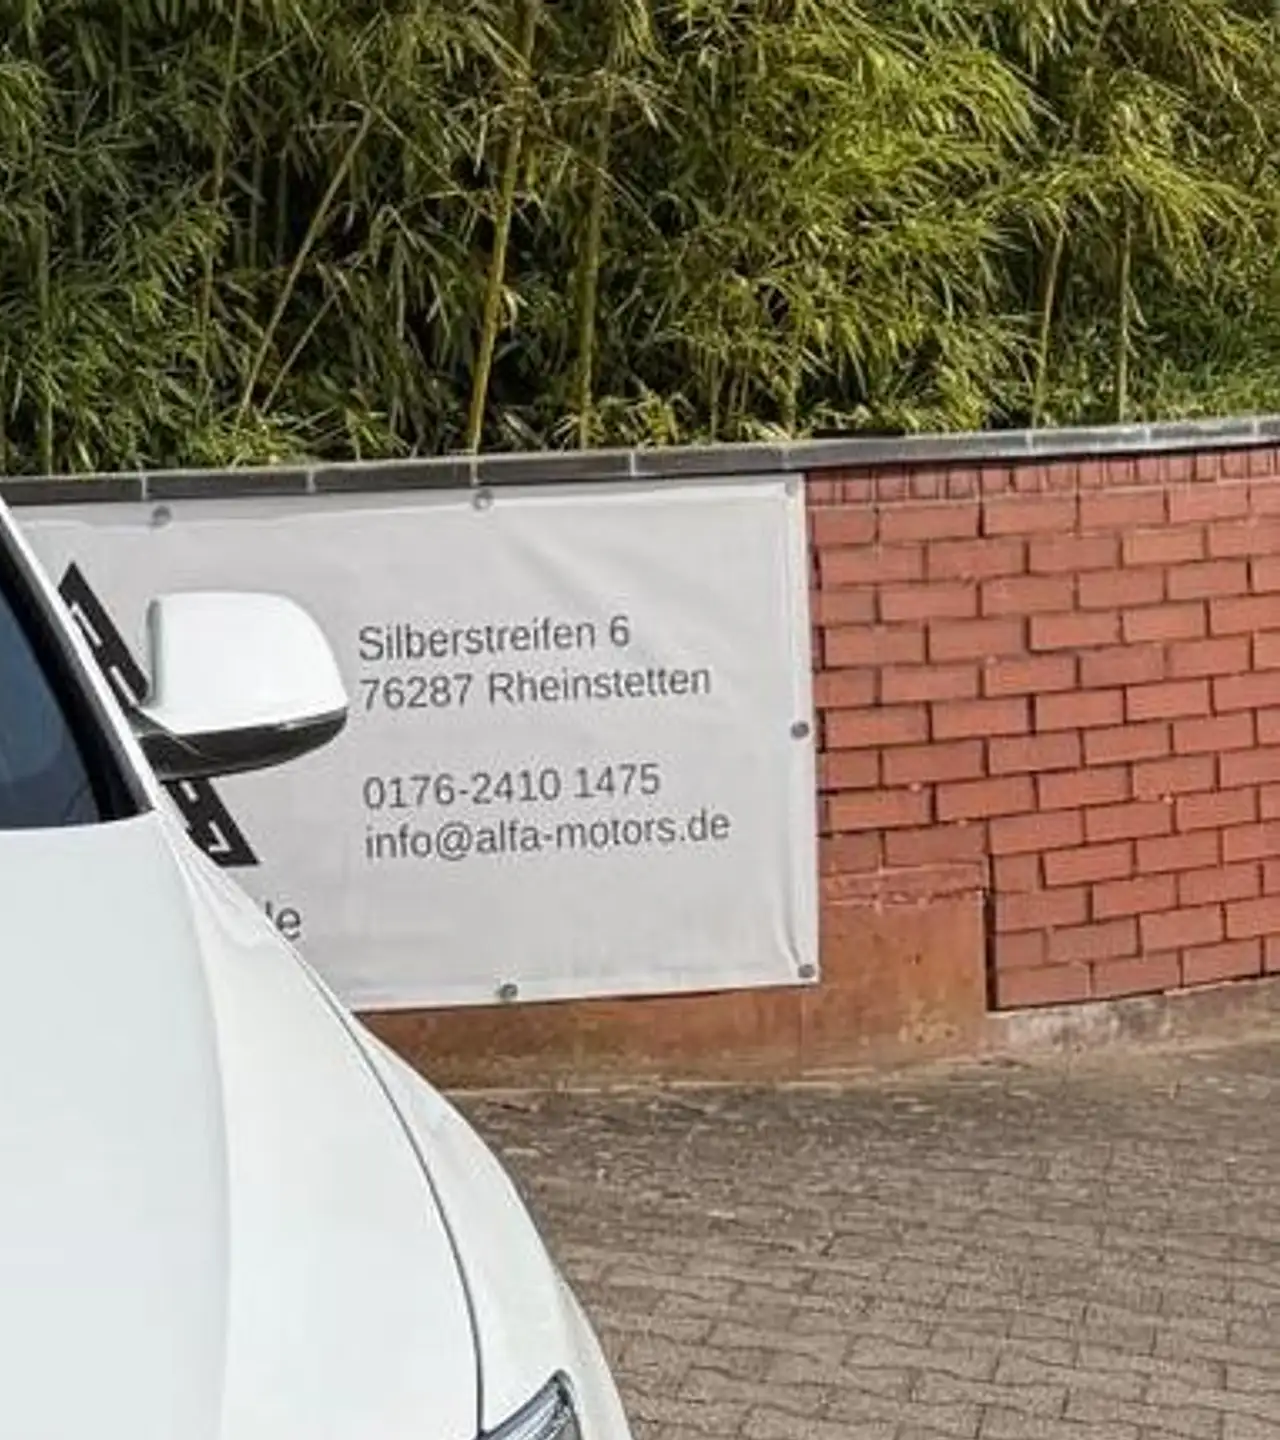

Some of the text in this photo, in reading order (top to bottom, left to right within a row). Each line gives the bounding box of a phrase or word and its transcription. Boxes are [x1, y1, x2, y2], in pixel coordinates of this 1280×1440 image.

[358, 614, 631, 661] Silberstreifen 6
[359, 667, 711, 711] 76287 Rheinstetten
[363, 763, 661, 809] 0176-2410 1475
[365, 808, 731, 861] info@alfa-motors.de
